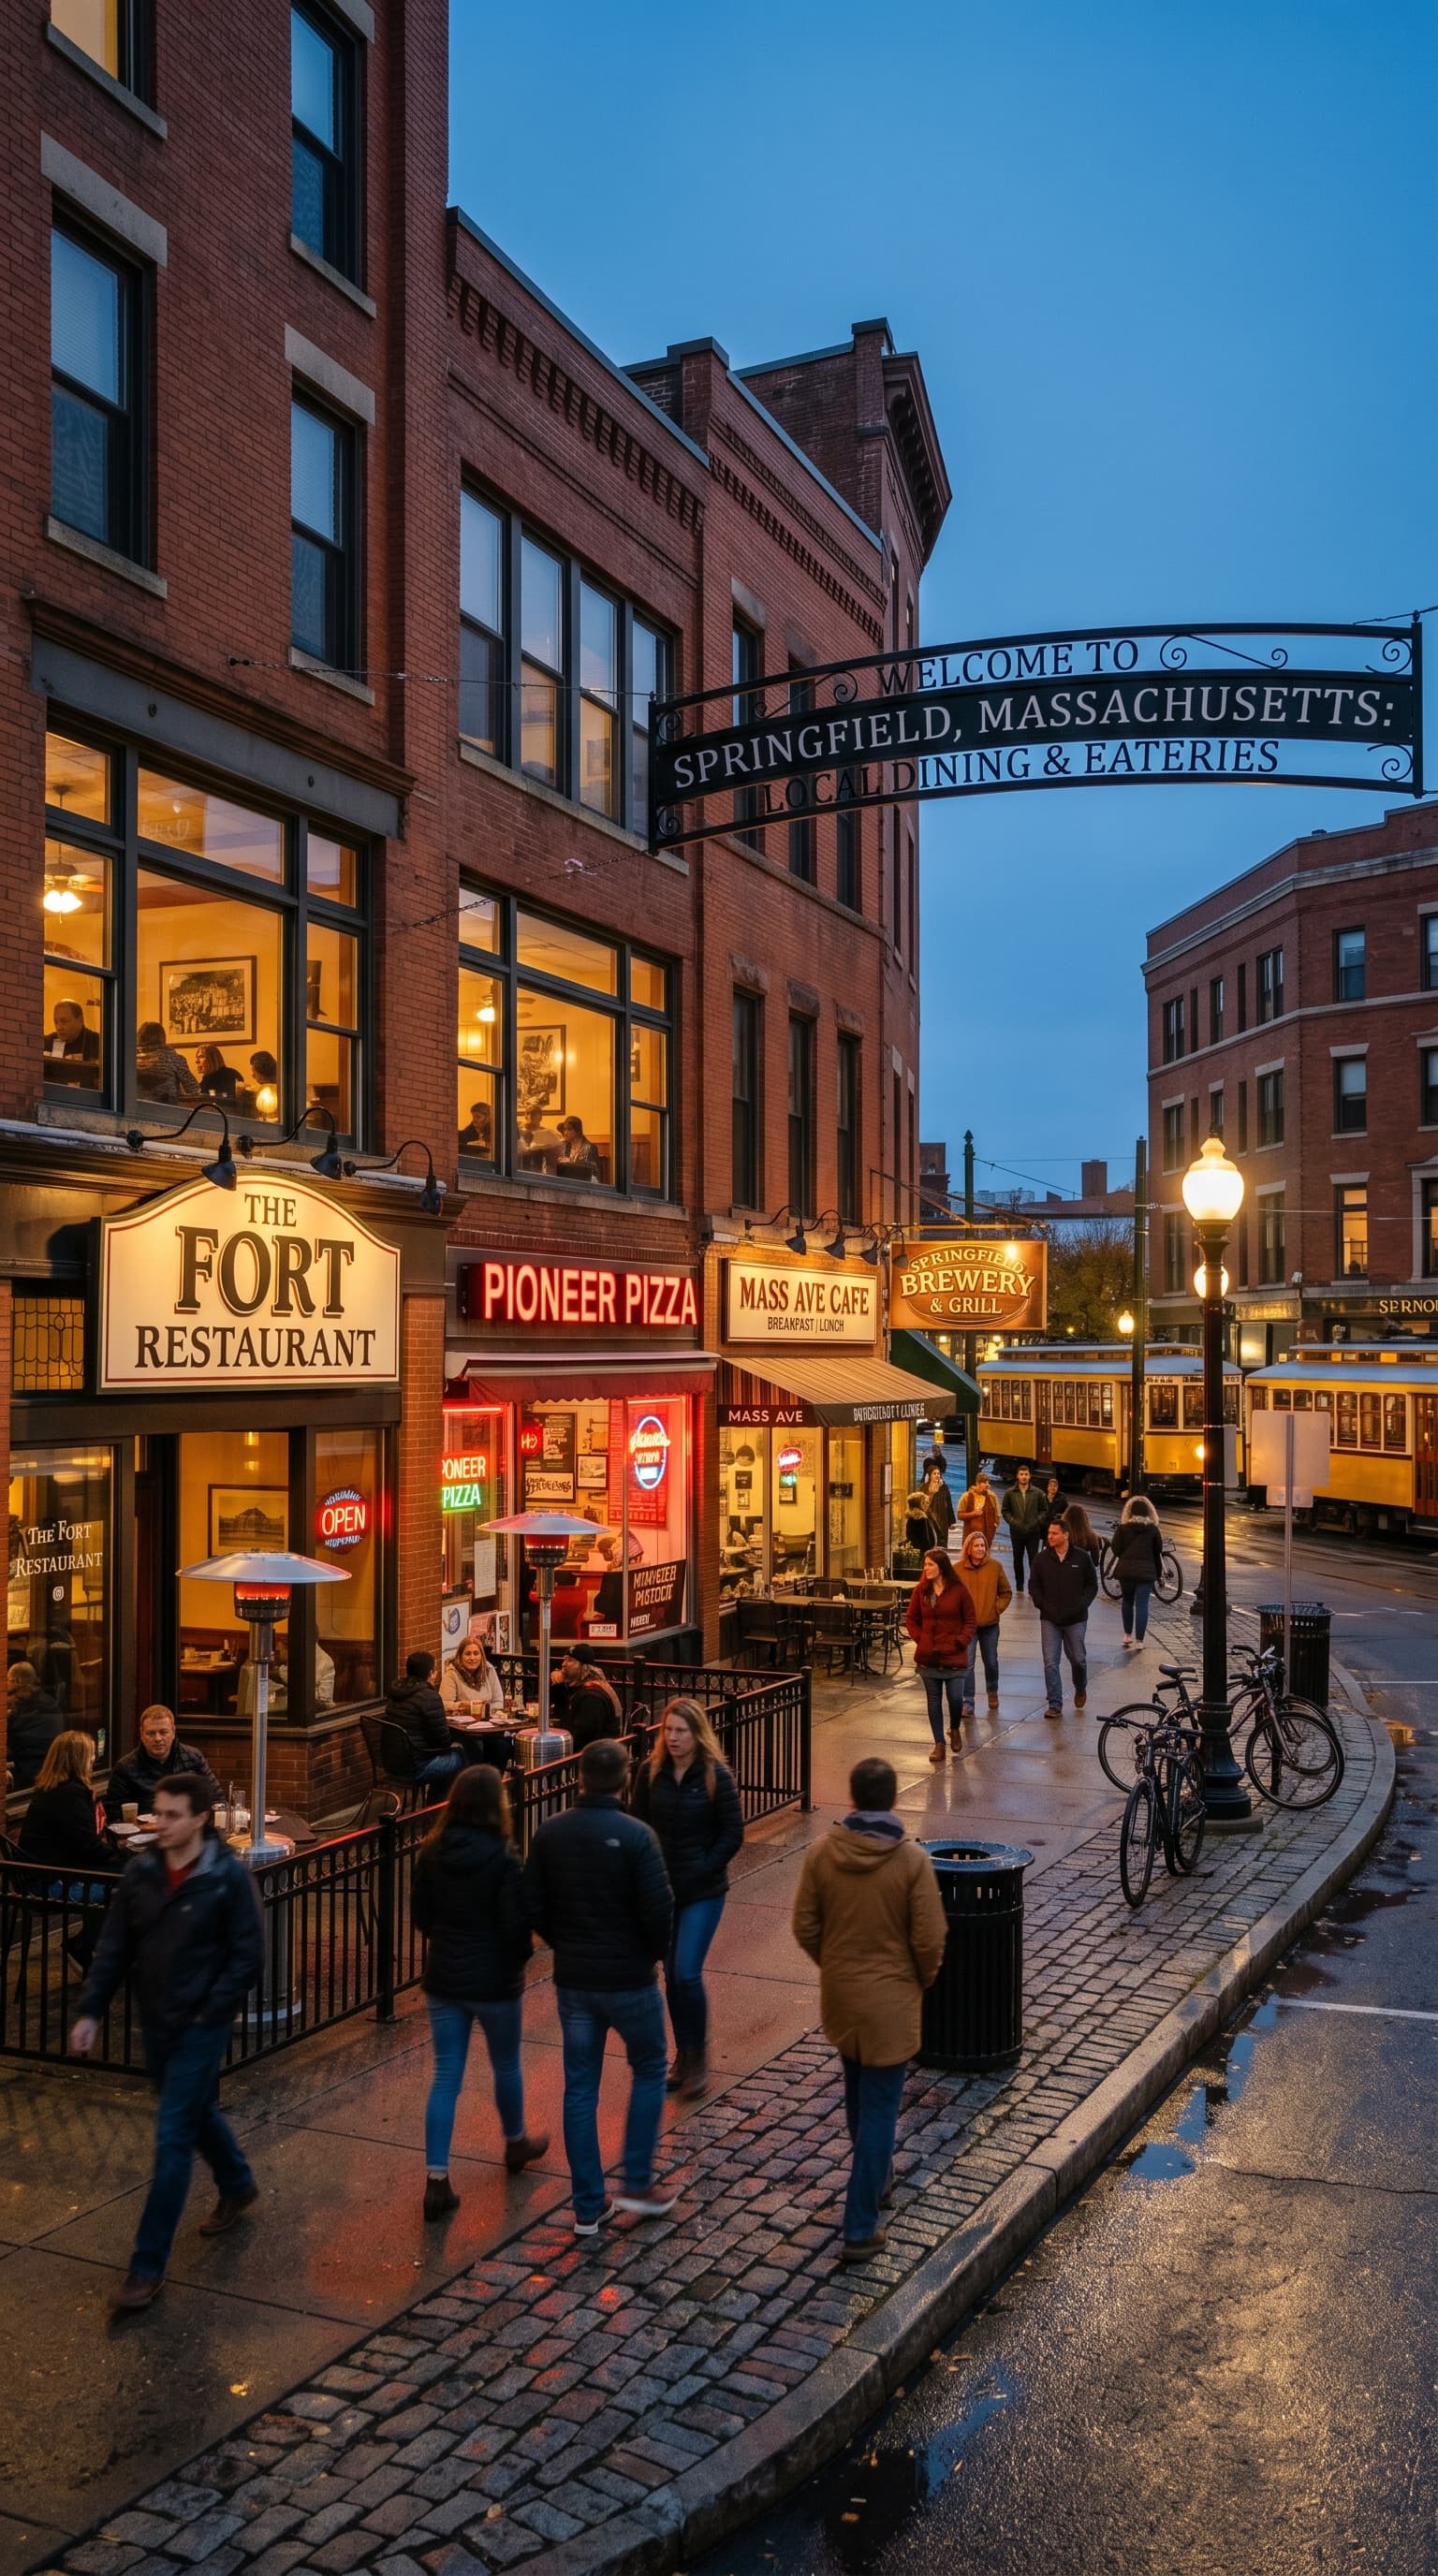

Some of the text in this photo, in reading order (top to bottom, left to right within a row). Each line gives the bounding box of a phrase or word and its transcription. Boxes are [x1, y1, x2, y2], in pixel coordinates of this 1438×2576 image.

[876, 639, 1138, 695] WELCOME TO
[674, 686, 1393, 788] SPRINGFIELD, MASSACHUSETTS:
[764, 739, 1279, 813] LOCAL DINING & EATERIES
[244, 1193, 297, 1227] THE
[175, 1224, 355, 1318] FORT
[911, 1248, 1025, 1274] SPRINGFIELD
[484, 1262, 697, 1325] PIONEER PIZZA
[740, 1277, 870, 1315] MASS AVE CAFE
[899, 1268, 1035, 1297] BREWERY
[930, 1296, 1003, 1314] & GRILL
[135, 1325, 376, 1368] RESTAURANT
[728, 1410, 803, 1423] MASS AVE
[442, 1484, 481, 1509] PIZZA
[321, 1504, 366, 1535] OPEN
[14, 1552, 103, 1578] RESTAURANT
